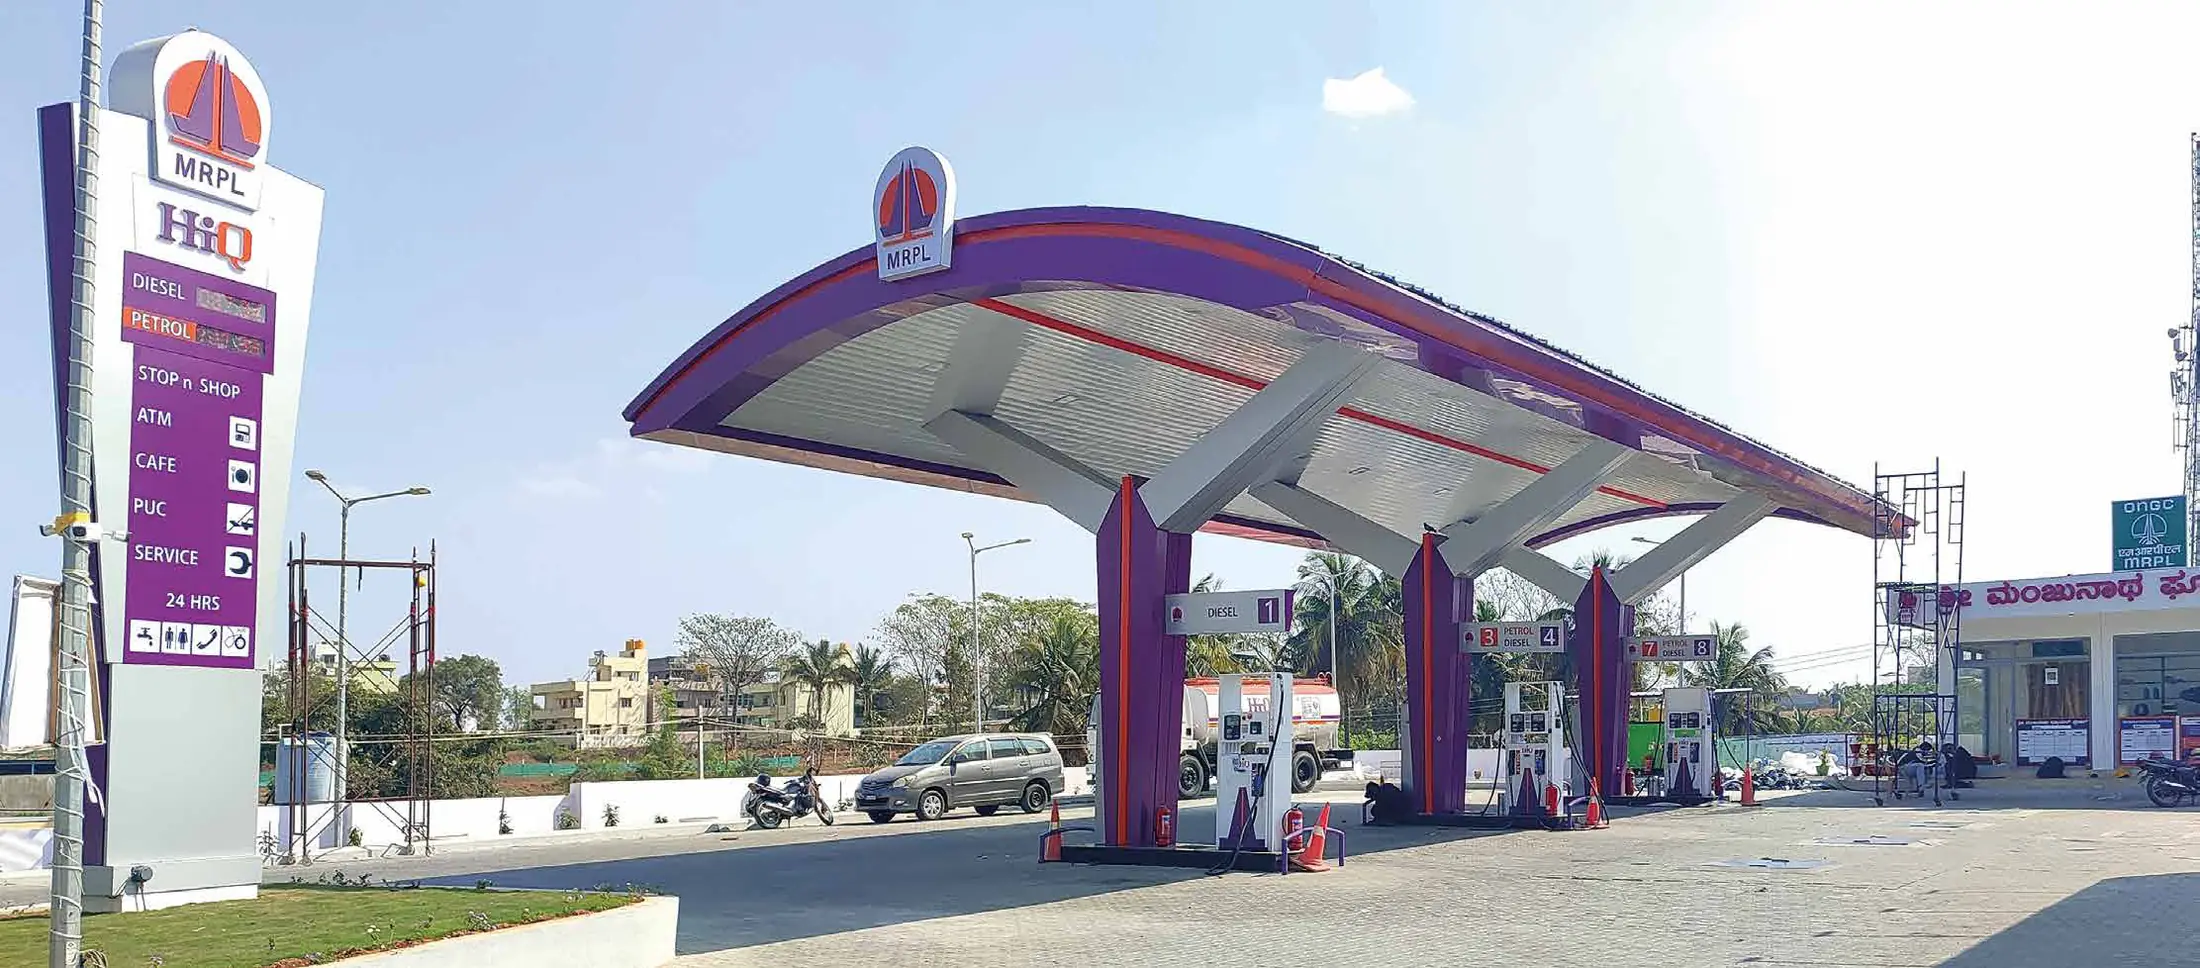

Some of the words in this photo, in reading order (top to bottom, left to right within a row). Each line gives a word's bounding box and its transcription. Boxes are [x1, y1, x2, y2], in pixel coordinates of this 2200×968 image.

[174, 152, 245, 197] MRPL
[157, 201, 253, 271] HiQ
[887, 244, 931, 270] MRPL
[132, 272, 185, 300] DIESEL
[131, 311, 191, 339] PETROL
[138, 365, 179, 387] STOP
[183, 377, 192, 390] n
[200, 379, 241, 399] SHOP
[136, 408, 171, 427] ATM
[135, 453, 177, 473] CAFE
[134, 498, 167, 517] PUC
[134, 545, 199, 566] SERVICE
[2124, 555, 2175, 569] MRPL
[166, 593, 185, 608] 24
[190, 594, 220, 611] HRS
[1265, 600, 1273, 623] 1
[1207, 606, 1239, 619] DIESEL
[1484, 629, 1495, 646] 3
[1503, 626, 1535, 636] PETROL
[1543, 628, 1556, 645] 4
[1504, 638, 1531, 647] DIESEL
[1644, 642, 1655, 656] 7
[1697, 640, 1708, 655] 8
